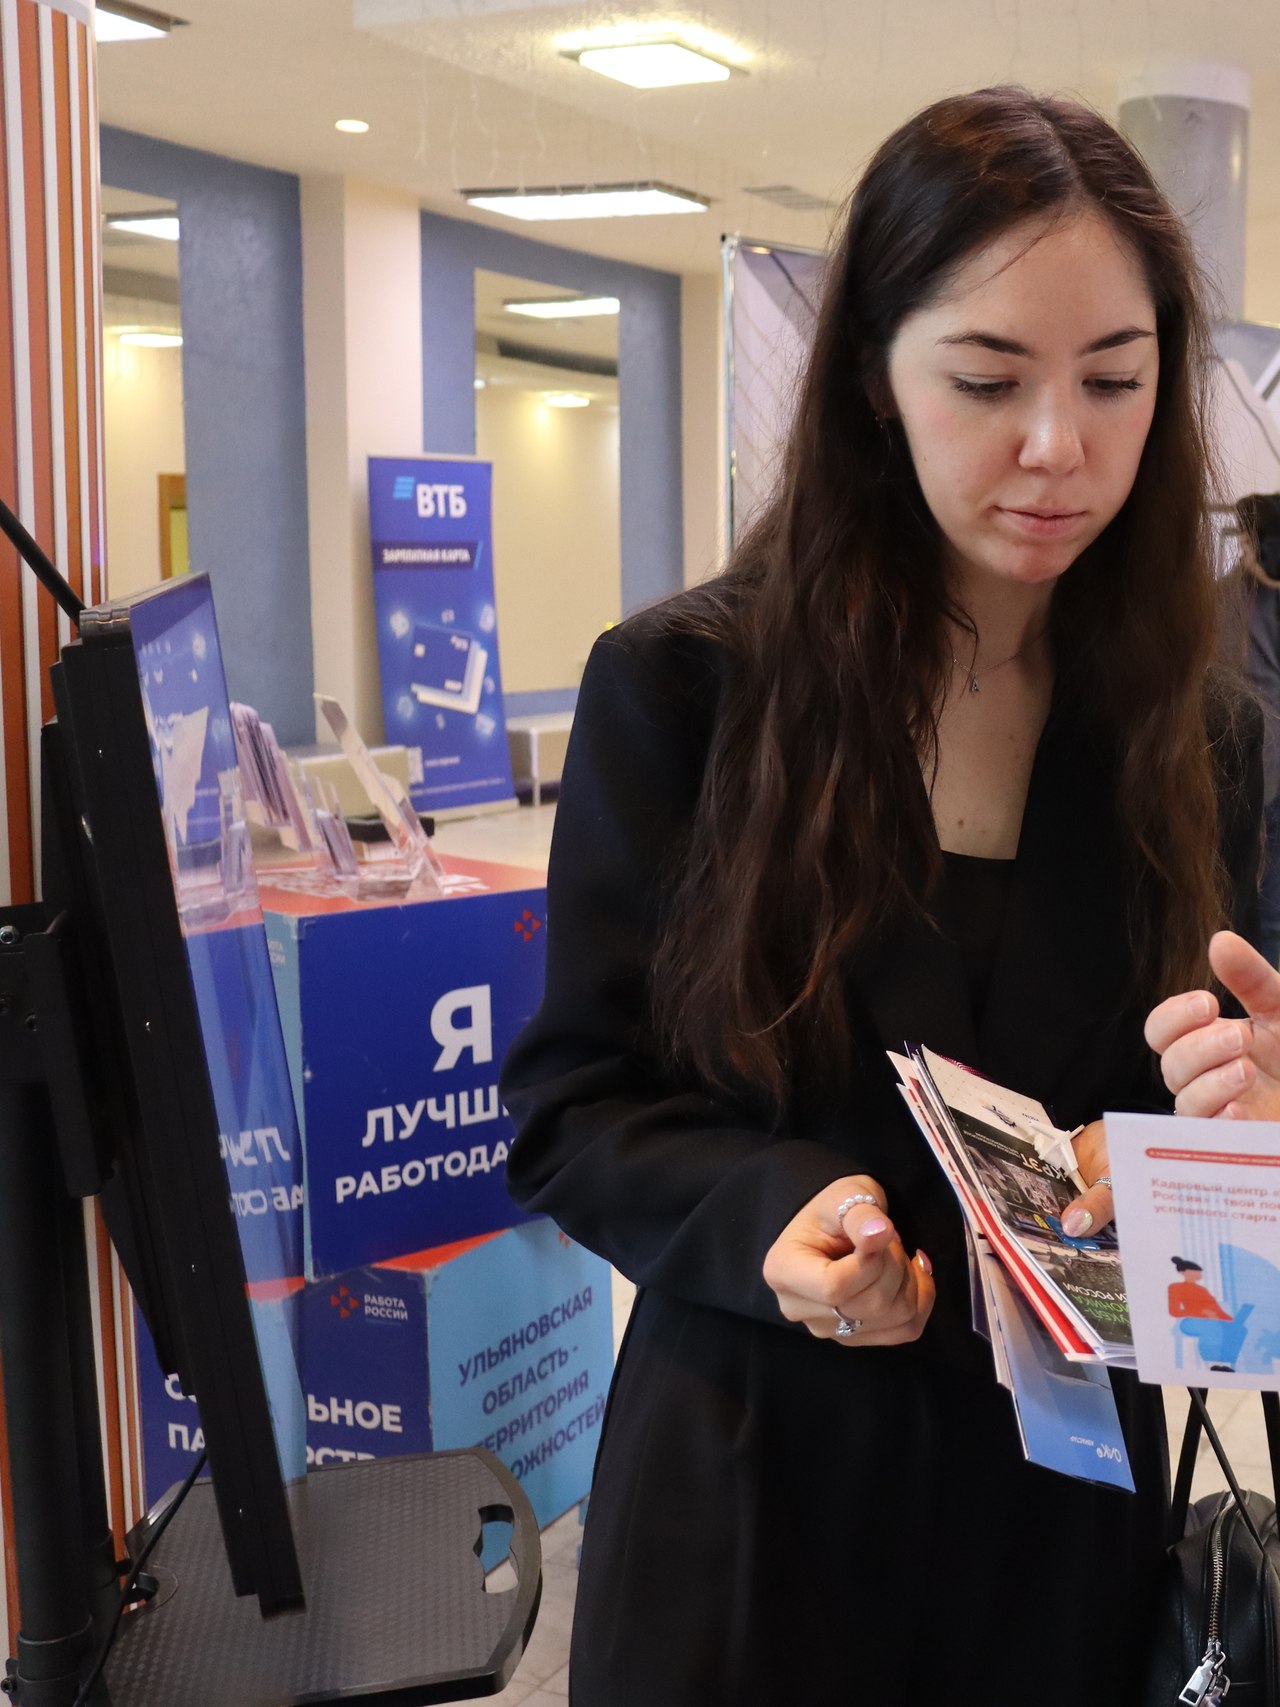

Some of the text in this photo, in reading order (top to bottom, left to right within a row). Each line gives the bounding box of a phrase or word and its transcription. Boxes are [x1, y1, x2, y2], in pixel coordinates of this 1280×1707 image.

[416, 484, 467, 518] ВТБ
[430, 983, 494, 1073] Я
[361, 1084, 510, 1148] ЛУЧШ
[335, 1137, 516, 1204] РАБОТОДА
[1151, 1178, 1223, 1192] Кадровый
[1227, 1186, 1268, 1198] центр
[1153, 1204, 1227, 1218] успешного
[1231, 1212, 1277, 1223] старта
[1224, 1198, 1255, 1209] твой
[364, 1294, 406, 1309] РАБОТА
[364, 1307, 409, 1321] РОССИИ
[1062, 1281, 1115, 1301] РОССИИ
[458, 1285, 593, 1387] УЛЬЯНОВСКАЯ
[482, 1347, 569, 1415] ОБЛАСТЬ
[475, 1369, 590, 1454] ЕРРИТОРИЯ
[510, 1392, 607, 1480] ОЖНОСТЕЙ
